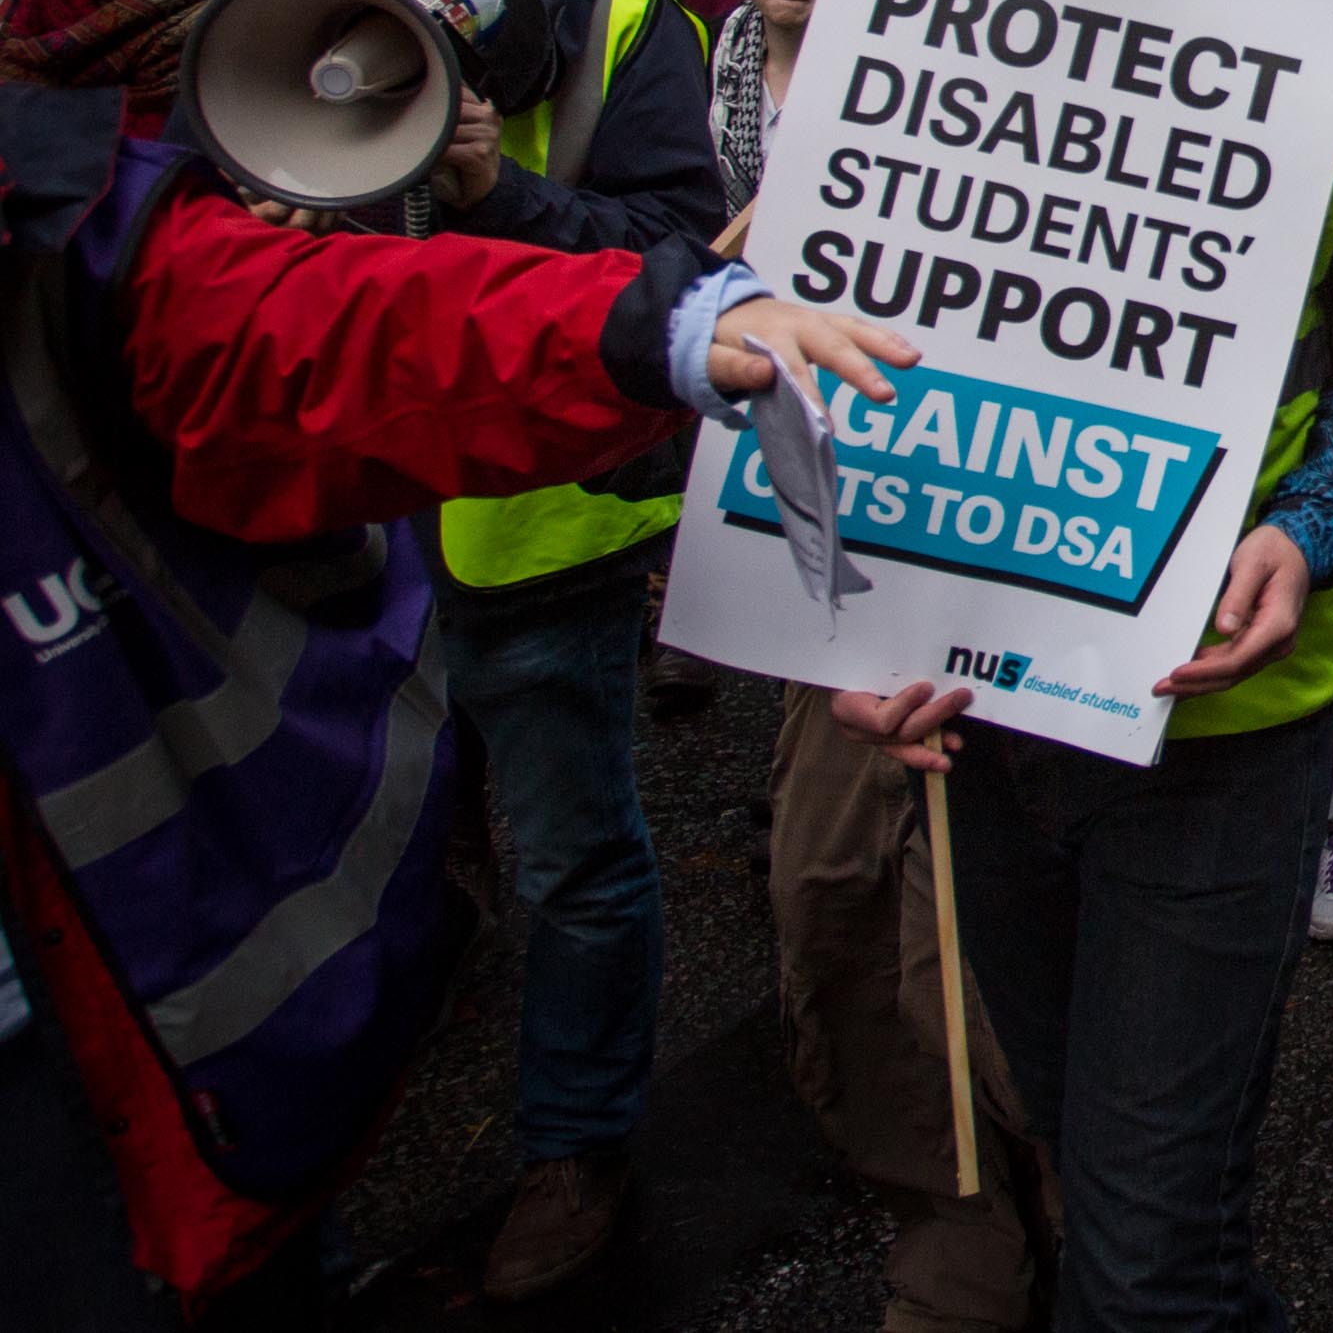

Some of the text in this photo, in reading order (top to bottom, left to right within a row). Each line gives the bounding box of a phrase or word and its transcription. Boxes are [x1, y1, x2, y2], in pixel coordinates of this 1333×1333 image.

[840, 54, 1273, 211] DISABLED
[818, 148, 1256, 292] STUDENTS'
[792, 229, 1238, 389] SUPPORT
[743, 449, 1133, 579] CTS TO DSA
[818, 382, 1196, 513] GAINST
[944, 646, 1141, 719] nus disabled students
